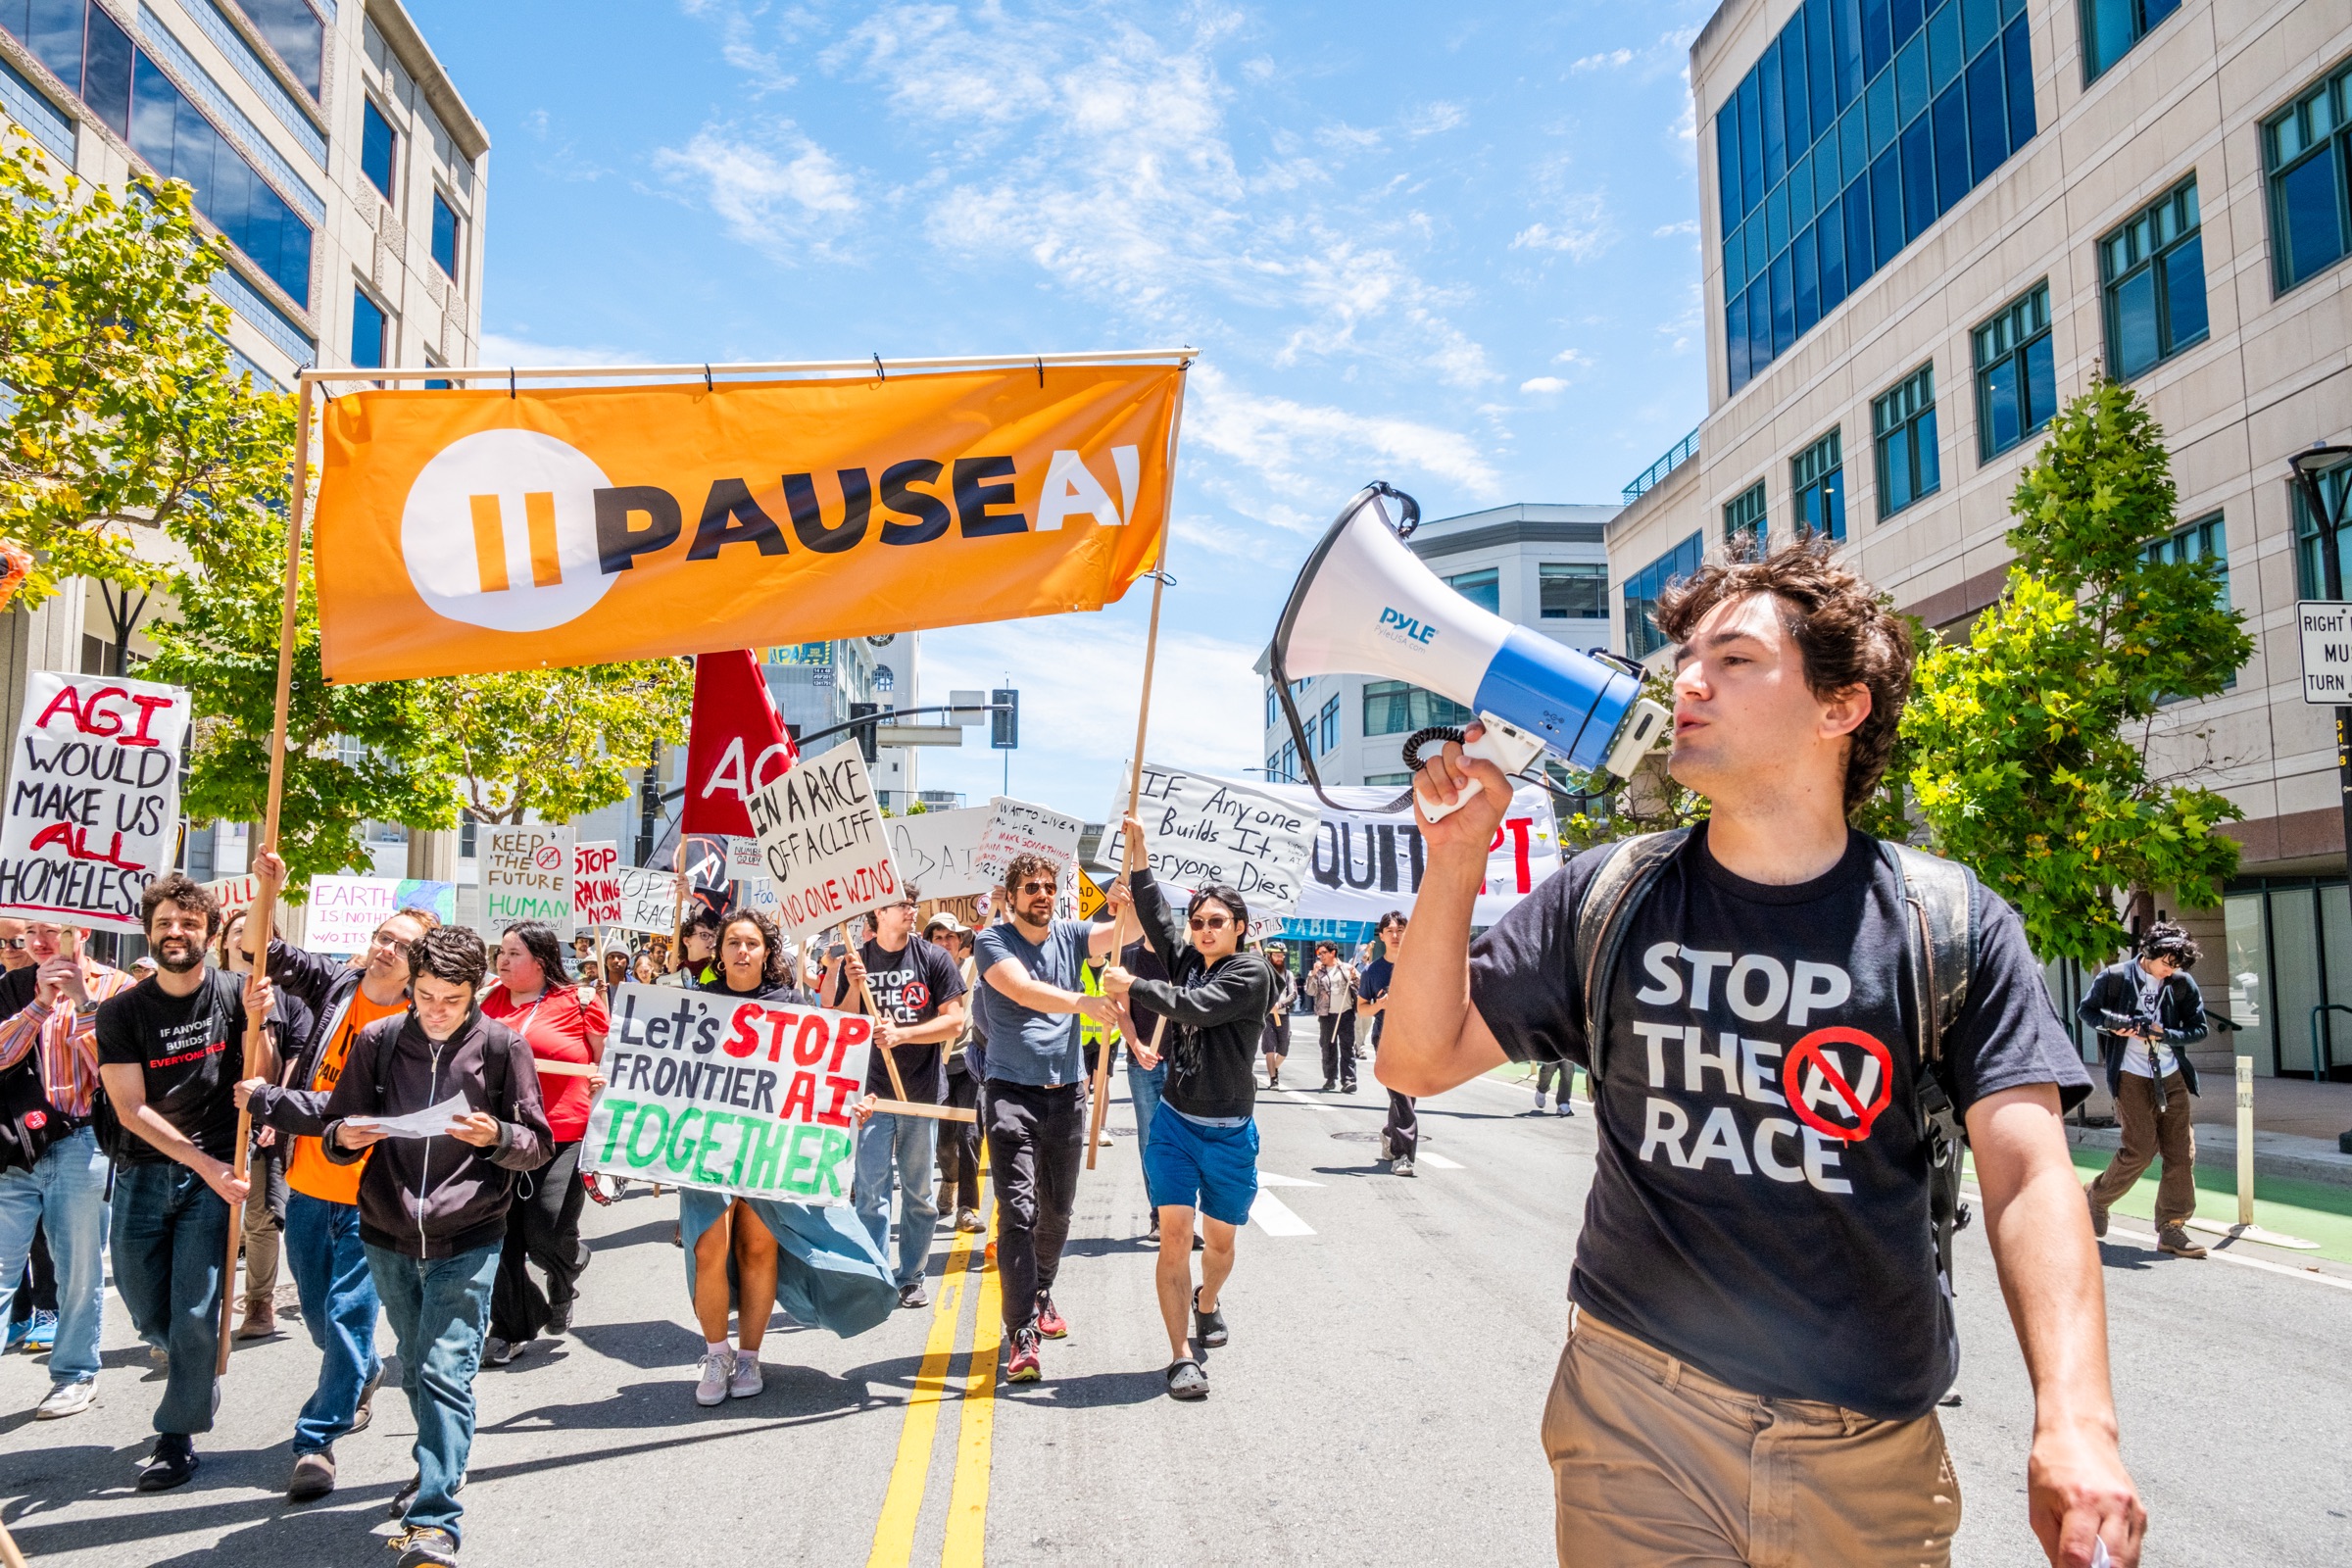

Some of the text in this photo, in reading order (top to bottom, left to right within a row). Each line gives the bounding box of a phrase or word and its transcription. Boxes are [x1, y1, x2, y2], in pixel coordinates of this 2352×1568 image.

[2304, 615, 2343, 632] RIGHT
[2325, 644, 2352, 662] MU
[2308, 675, 2344, 690] TURN
[35, 685, 173, 747] AGI
[25, 736, 171, 789] WOULD
[750, 759, 868, 838] IN A RACE
[1128, 769, 1187, 802] IF
[12, 780, 165, 836] MAKE US
[1042, 814, 1066, 829] LIVE
[1159, 806, 1219, 843] Builds
[1202, 786, 1301, 835] Anyone
[29, 821, 145, 871] ALL
[492, 833, 545, 854] KEEP
[767, 808, 873, 883] OFF A CLIFF
[1021, 837, 1070, 860] SOMETHING
[1312, 820, 1425, 894] QUIT
[494, 855, 534, 870] THE
[574, 846, 617, 875] STOP
[1109, 830, 1295, 904] Eeryone Dies.
[315, 885, 398, 908] EARTH
[488, 869, 564, 892] FUTURE
[574, 878, 620, 912] RACING
[781, 891, 805, 930] NO
[805, 879, 843, 917] ONE
[843, 858, 895, 906] WINS
[319, 909, 339, 922] IS
[488, 893, 569, 919] HUMAN
[588, 902, 622, 925] NOW
[342, 932, 367, 944] ITS
[866, 969, 914, 989] STOP
[1636, 941, 1852, 1027] STOP
[877, 1006, 918, 1023] ACE
[160, 1028, 172, 1038] IF
[619, 994, 871, 1073] Let's STOP
[1633, 1020, 1788, 1108] THE
[610, 1053, 861, 1128] FRONTIER AI
[599, 1099, 852, 1198] TOGETHER
[1639, 1097, 1853, 1195] RACE
